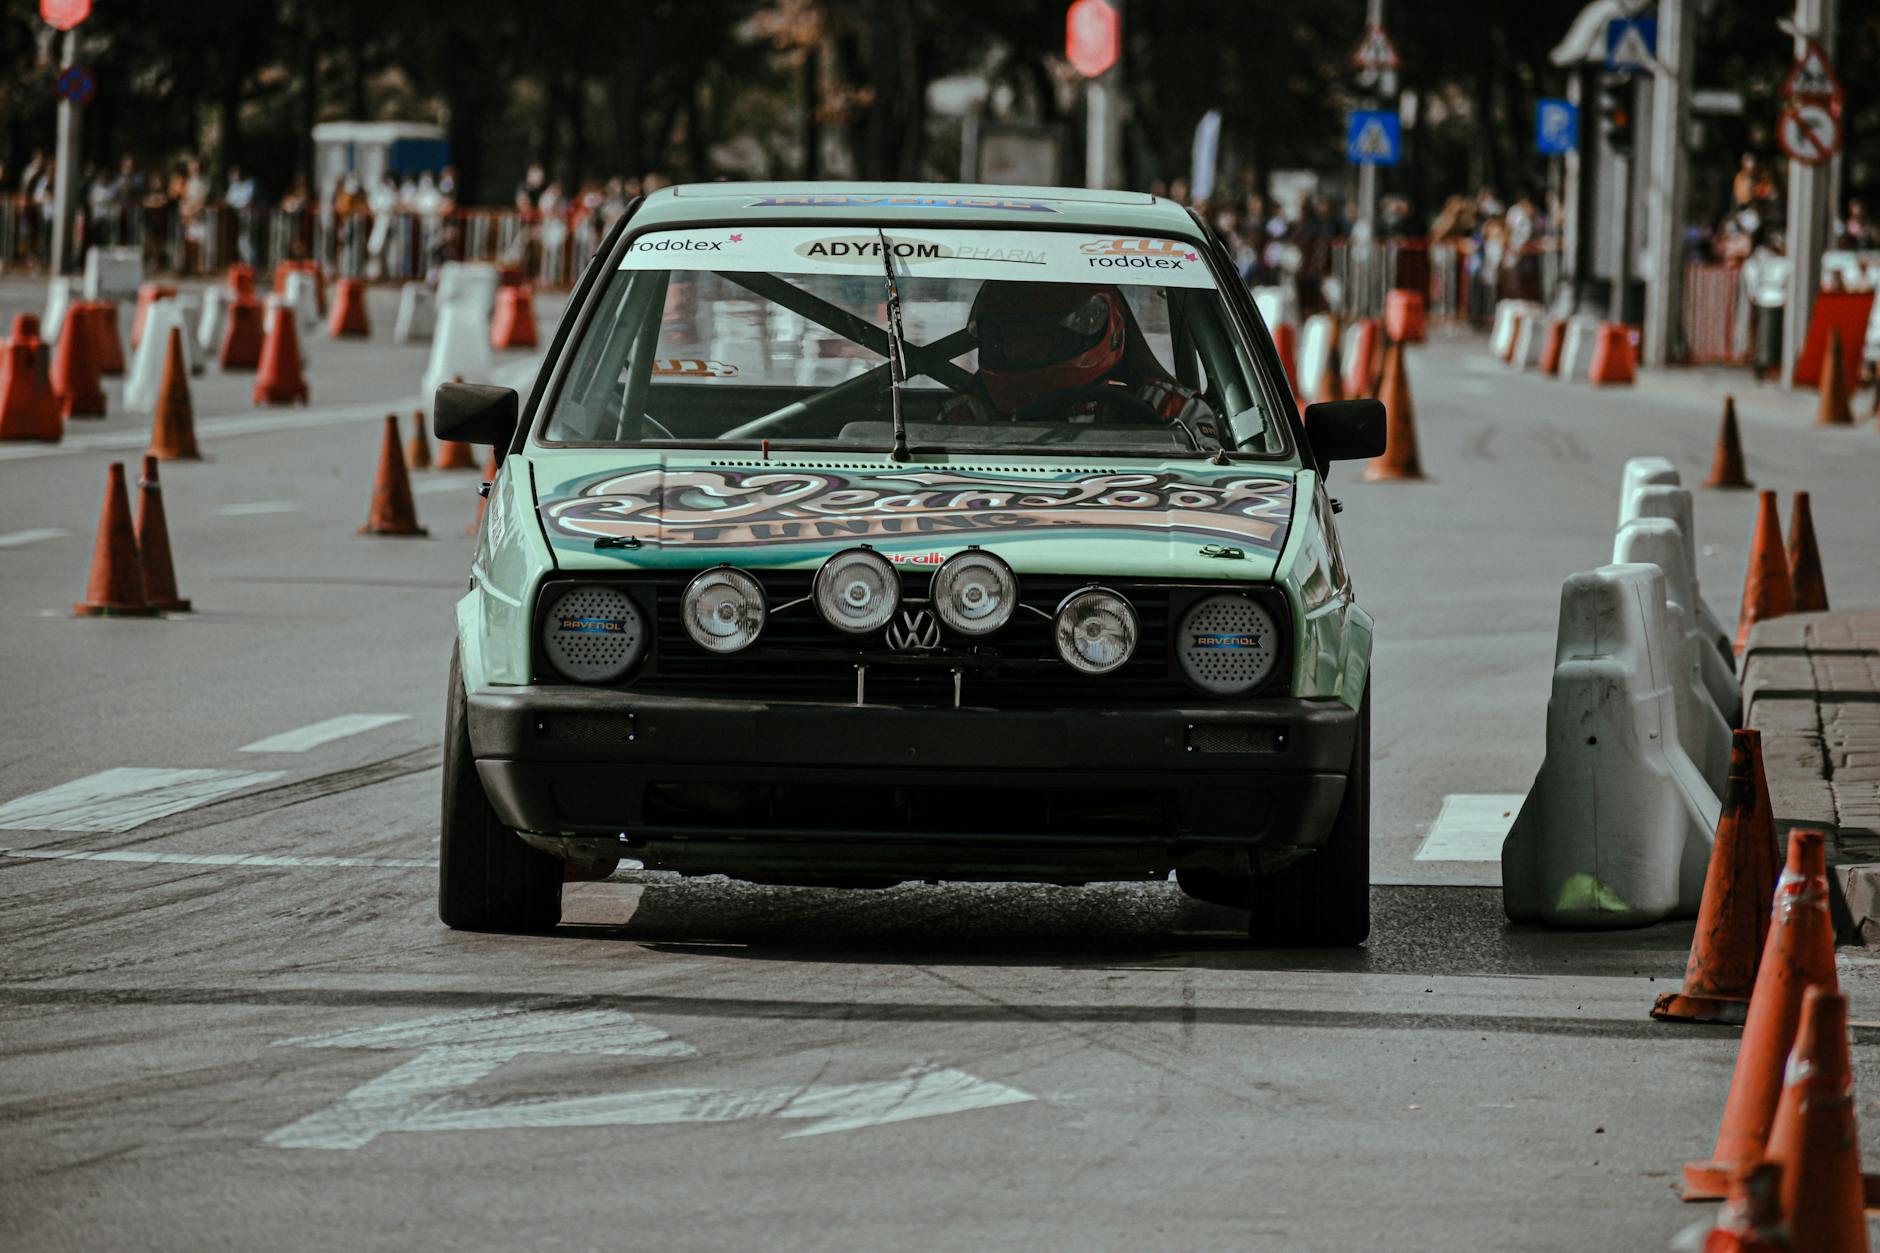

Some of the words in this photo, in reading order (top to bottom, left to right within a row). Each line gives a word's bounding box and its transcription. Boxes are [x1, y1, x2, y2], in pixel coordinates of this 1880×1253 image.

[630, 240, 722, 252] rodotex
[956, 245, 1046, 264] PHARM
[1089, 256, 1184, 269] rodotex
[562, 620, 622, 631] RAVENOL
[891, 610, 937, 650] VW
[1197, 637, 1257, 646] RAVENOL
